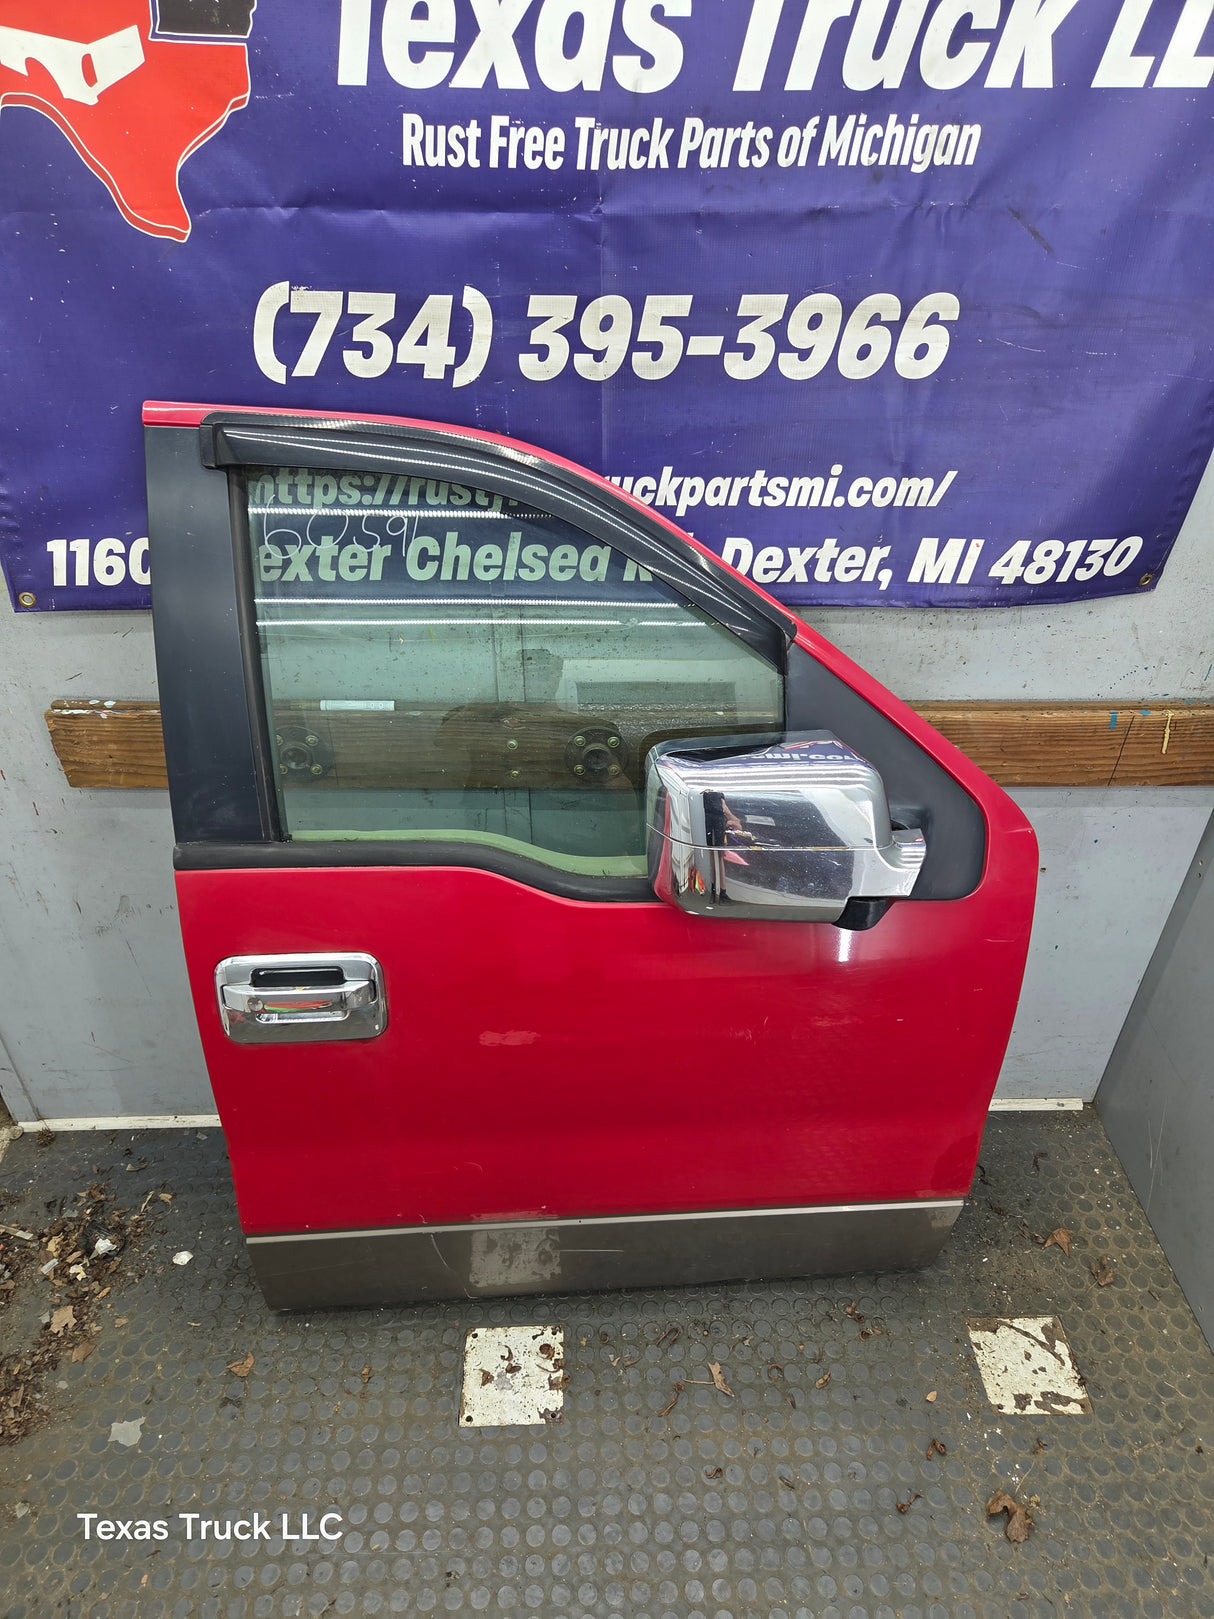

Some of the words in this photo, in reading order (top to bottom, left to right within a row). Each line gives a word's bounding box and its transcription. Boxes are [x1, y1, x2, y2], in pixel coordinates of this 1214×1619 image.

[338, 0, 692, 93] Texas
[402, 113, 482, 168] Rust
[490, 115, 566, 170] Free
[575, 117, 675, 170] Truck
[678, 117, 772, 169] Parts
[777, 115, 821, 167] of
[818, 114, 982, 173] Michigan
[253, 280, 493, 388] (734)
[518, 292, 961, 381] 395-3966
[258, 535, 392, 582] exter
[406, 531, 612, 582] Chelsea
[720, 537, 893, 590] Dexter,
[906, 538, 986, 584] MI
[988, 535, 1144, 584] 48130
